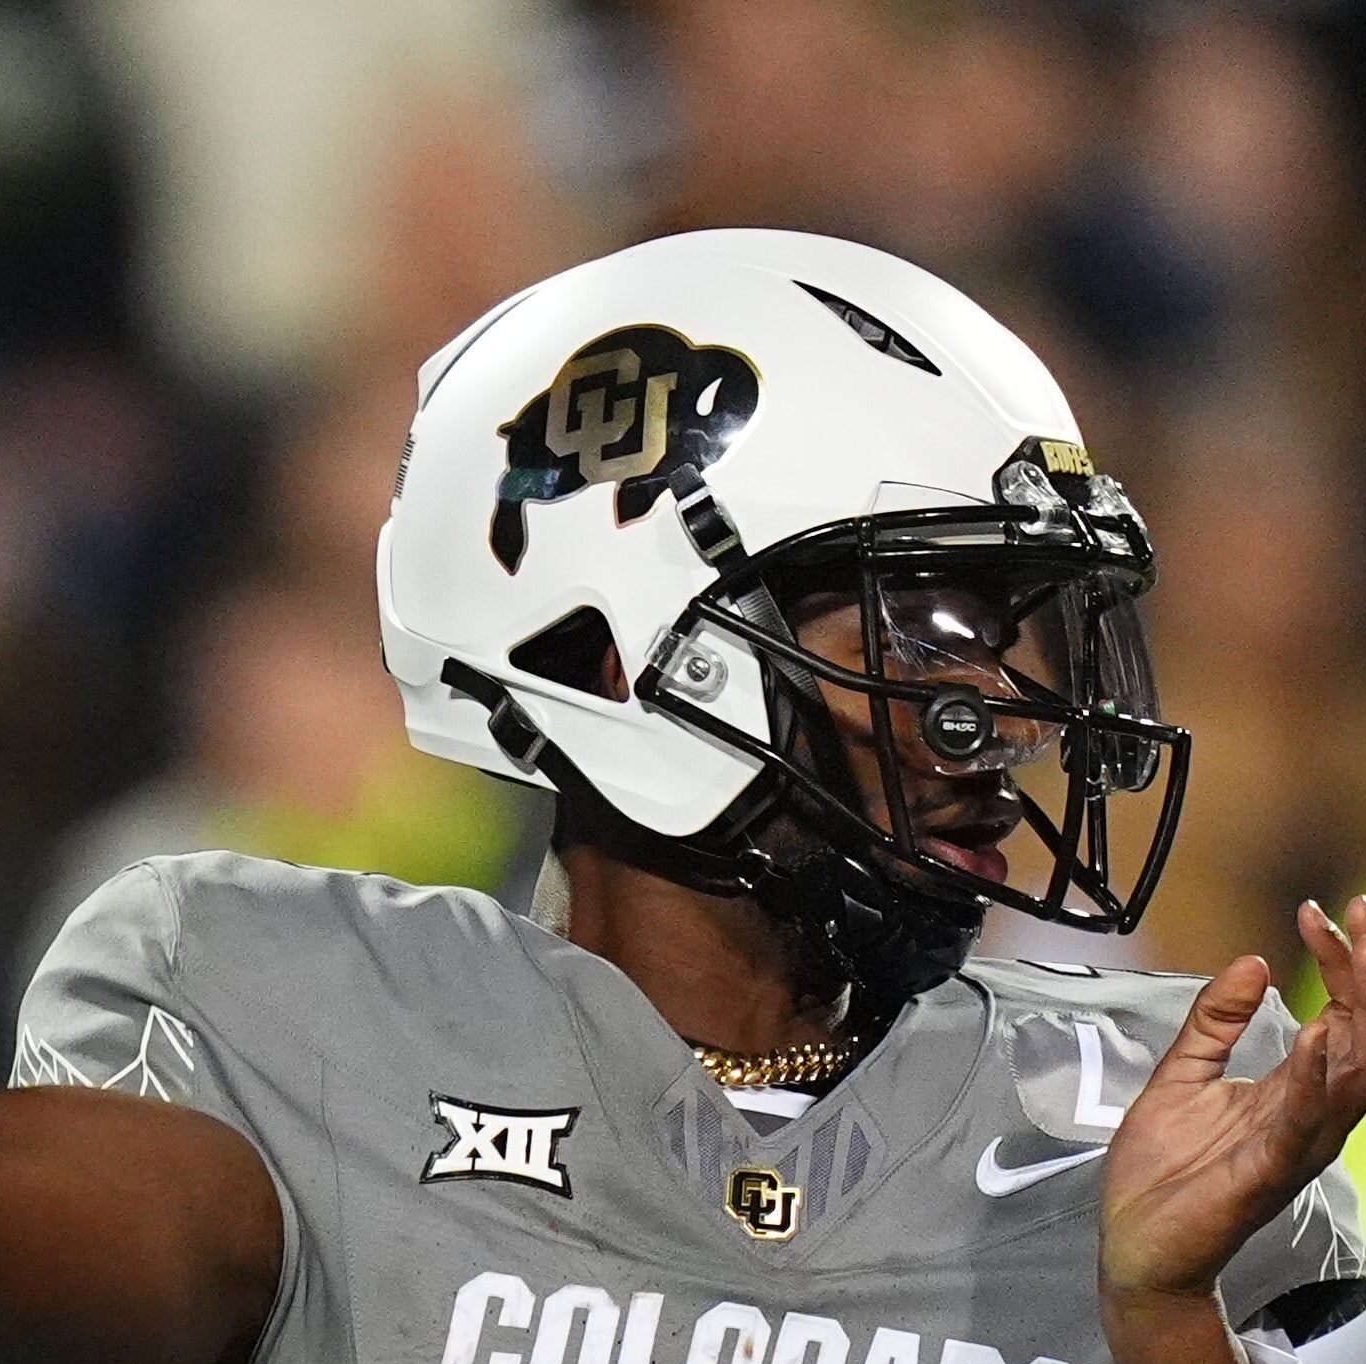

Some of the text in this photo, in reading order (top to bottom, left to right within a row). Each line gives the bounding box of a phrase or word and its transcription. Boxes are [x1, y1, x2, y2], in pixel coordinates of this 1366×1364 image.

[544, 348, 678, 485] CU
[423, 1093, 577, 1197] XII
[727, 1167, 805, 1239] CU
